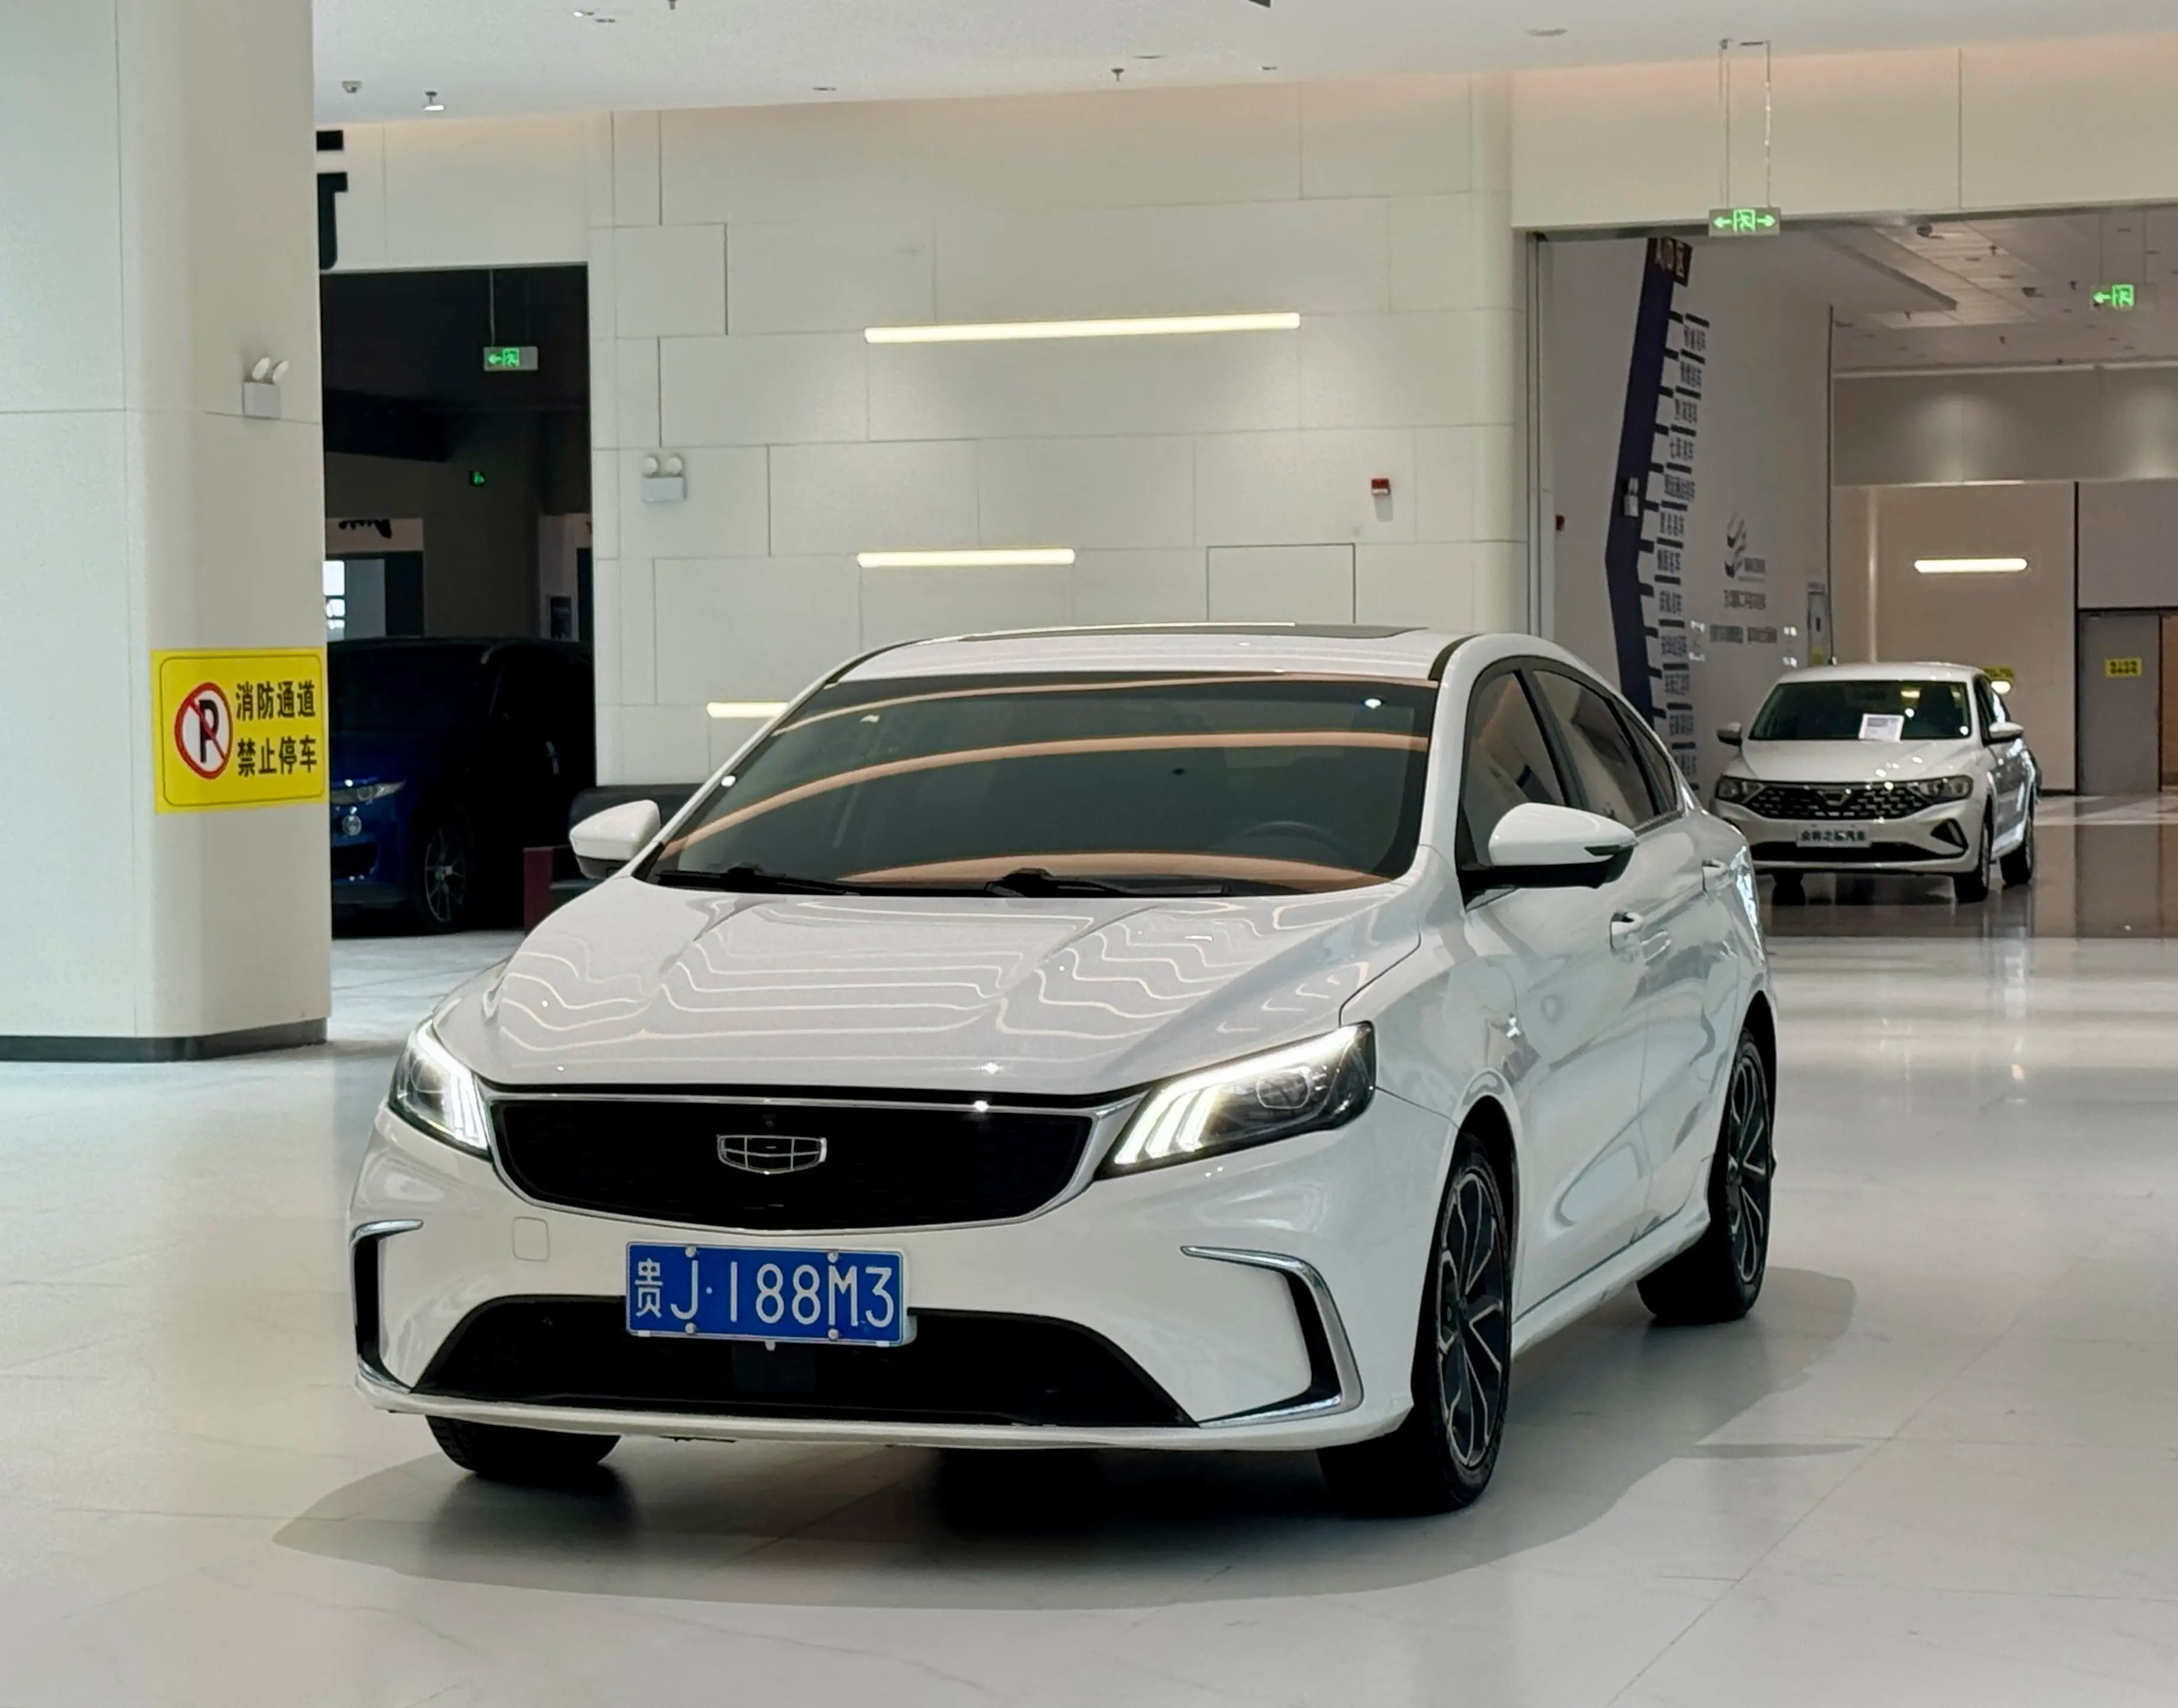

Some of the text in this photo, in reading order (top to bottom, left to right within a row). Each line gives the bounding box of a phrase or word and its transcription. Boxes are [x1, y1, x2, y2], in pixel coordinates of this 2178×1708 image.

[235, 680, 316, 722] 消防通道
[237, 735, 317, 777] 禁止停车
